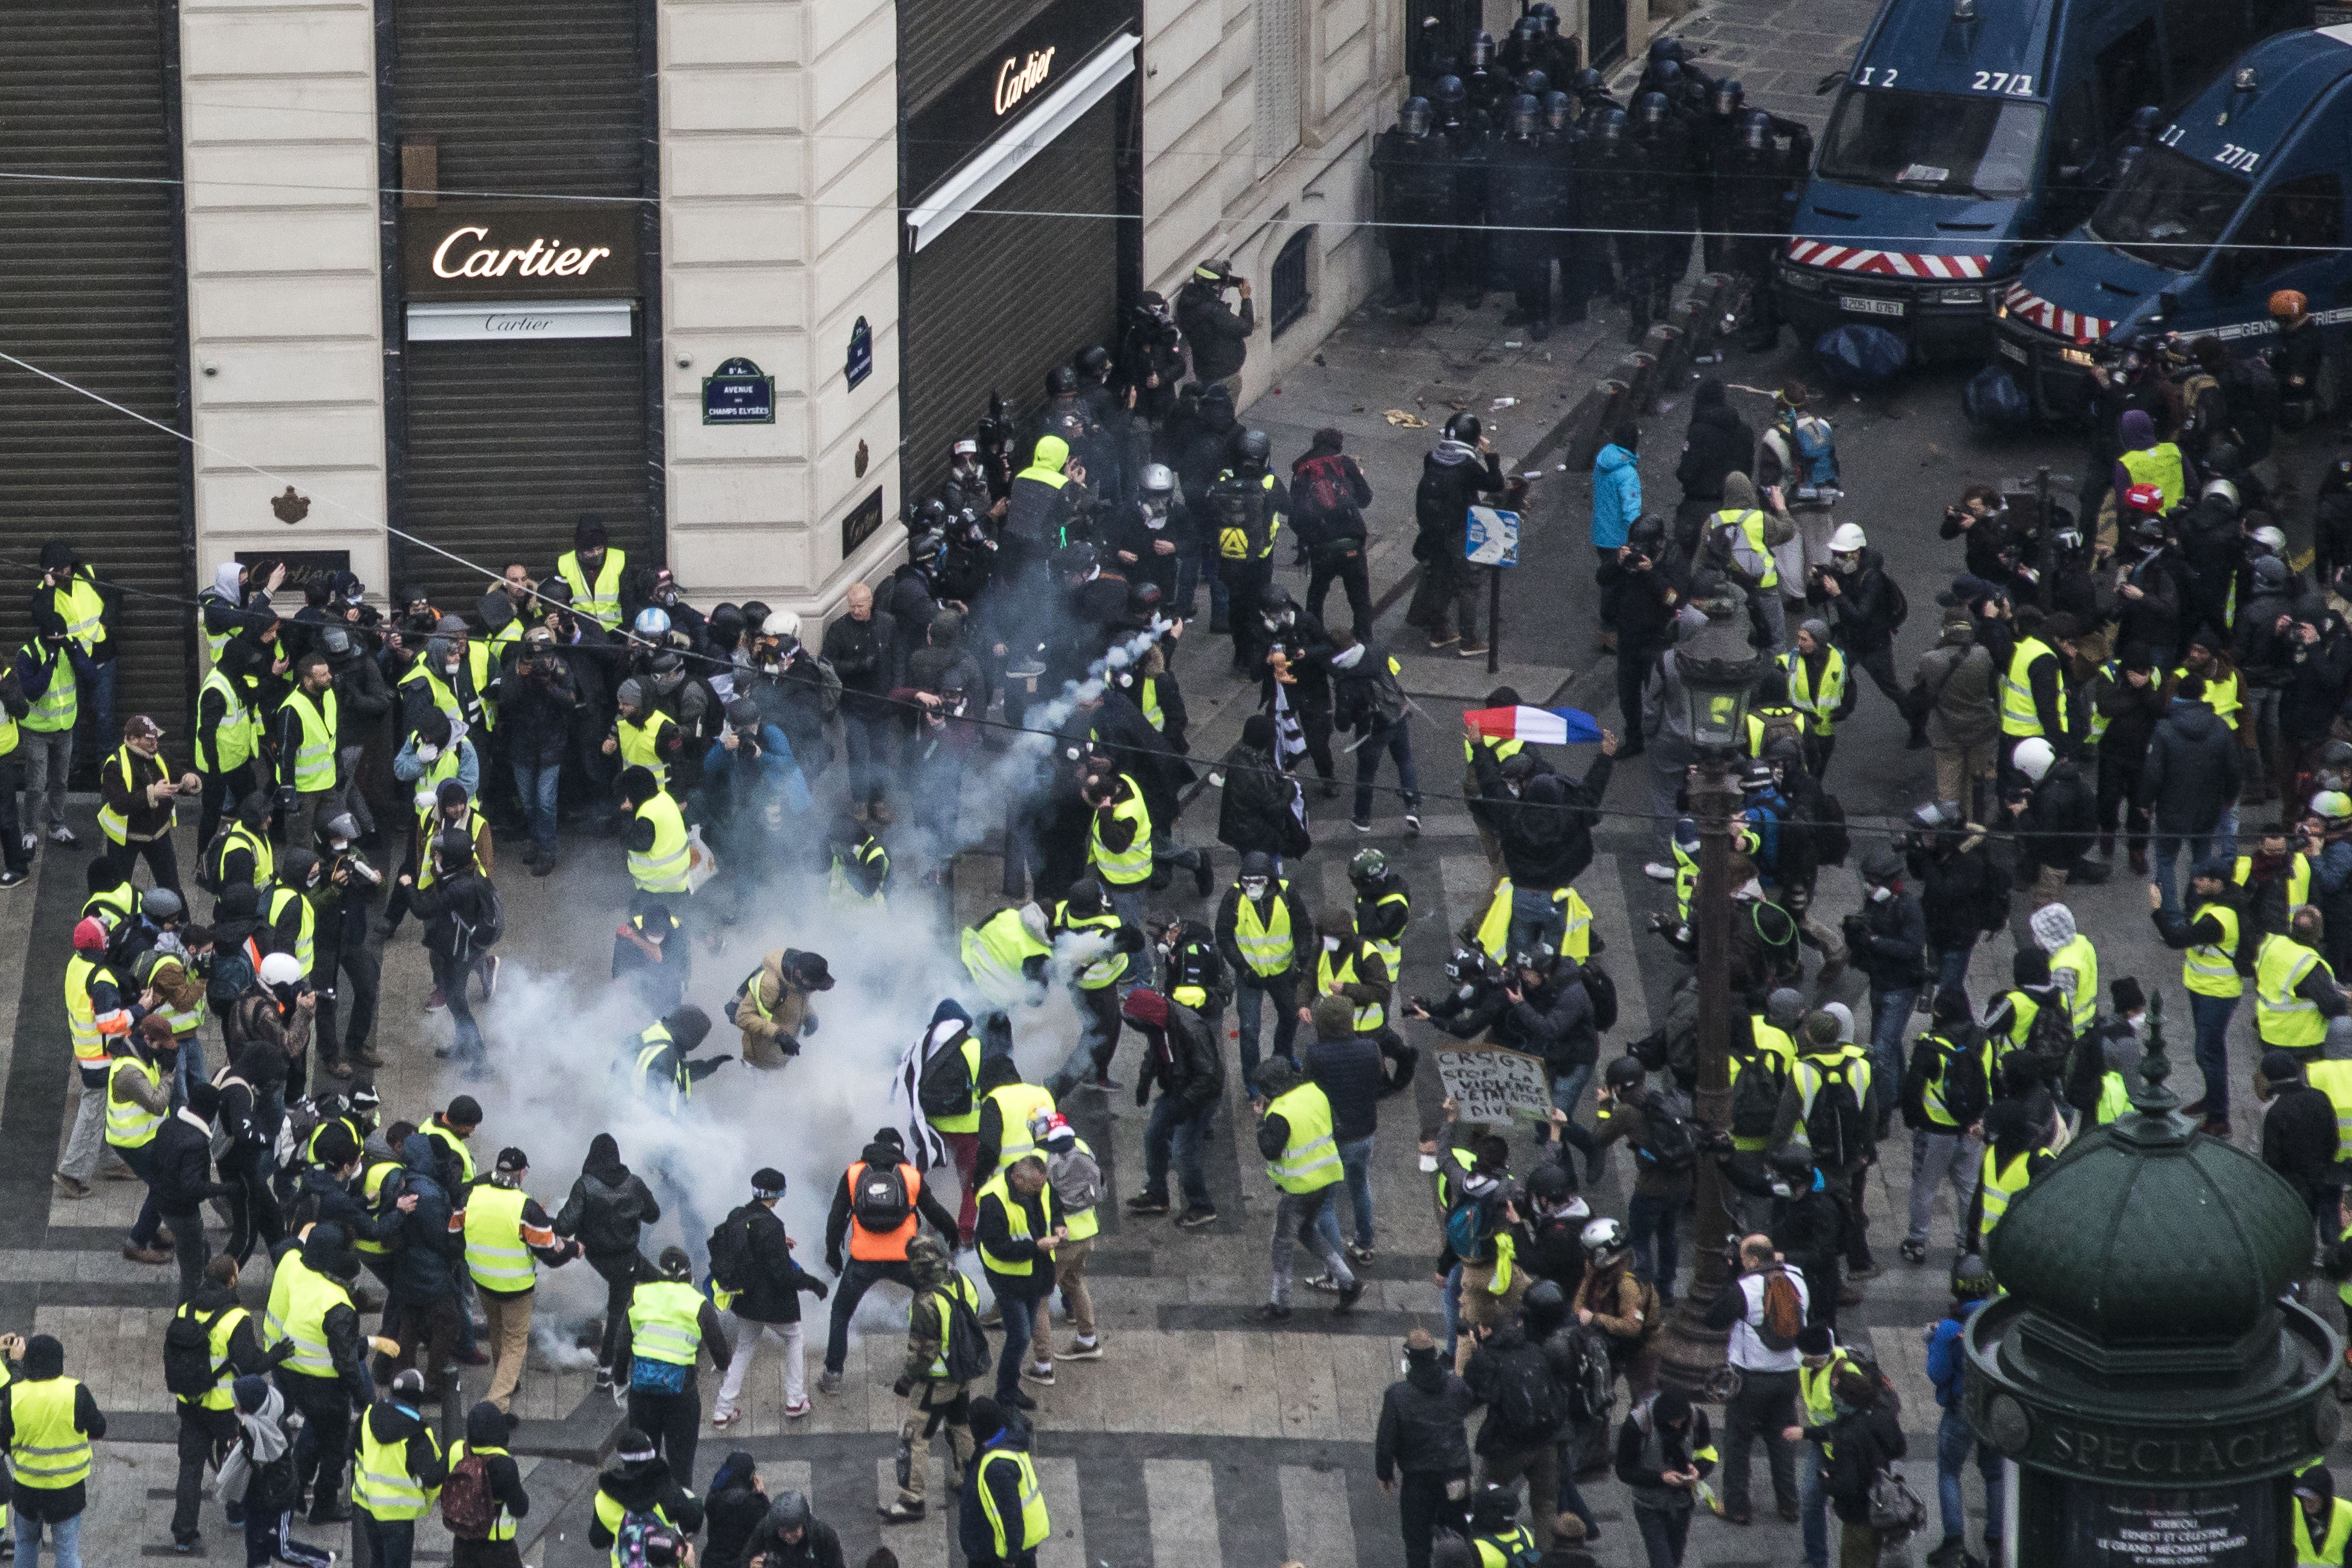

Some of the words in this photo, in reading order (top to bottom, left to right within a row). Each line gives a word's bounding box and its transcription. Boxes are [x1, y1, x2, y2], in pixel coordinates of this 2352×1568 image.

[996, 46, 1055, 115] Cartier
[433, 227, 610, 278] Cartier
[485, 314, 553, 331] Cartier
[2053, 1427, 2299, 1472] SPECTACLE
